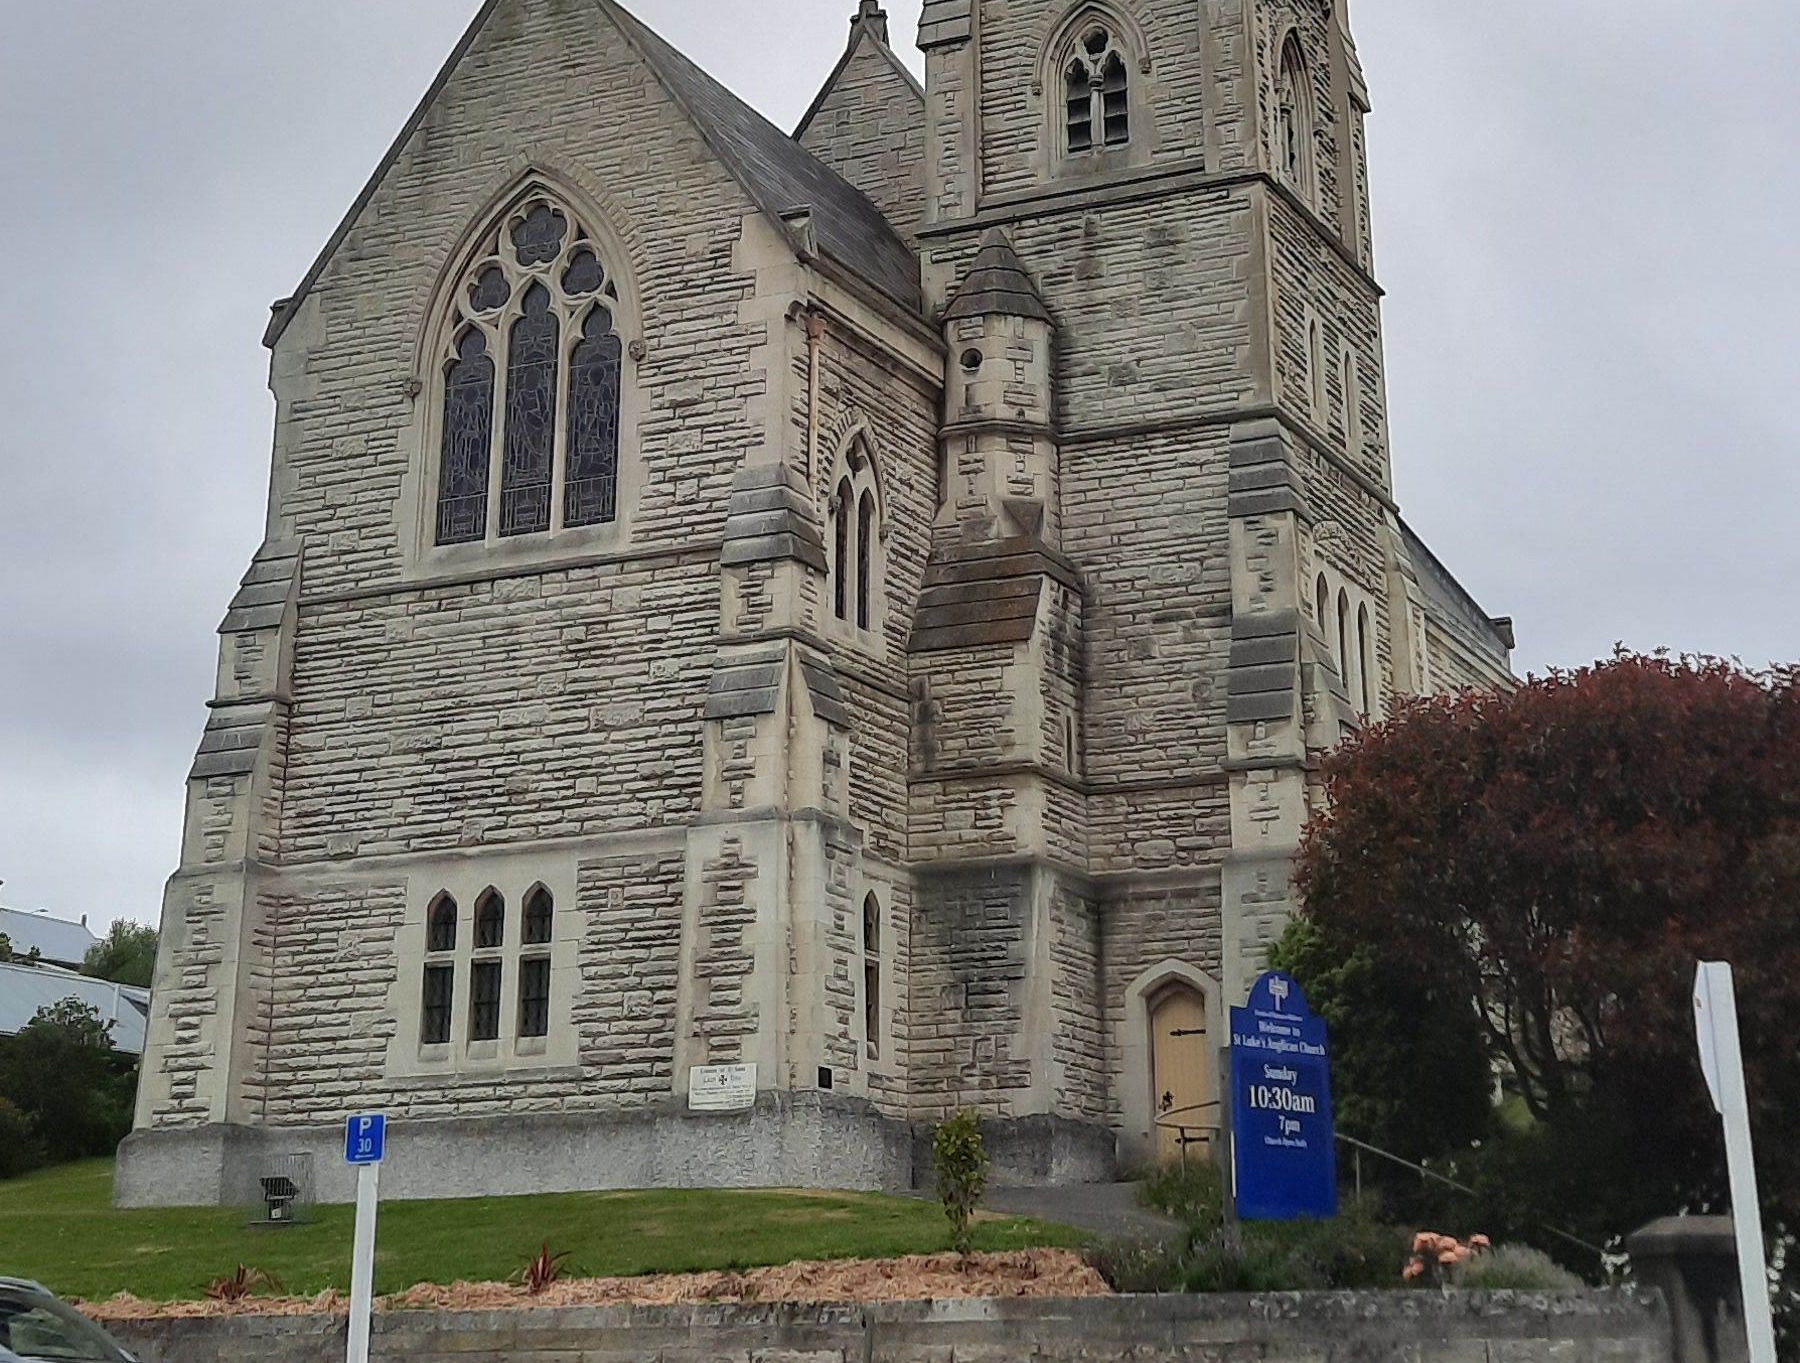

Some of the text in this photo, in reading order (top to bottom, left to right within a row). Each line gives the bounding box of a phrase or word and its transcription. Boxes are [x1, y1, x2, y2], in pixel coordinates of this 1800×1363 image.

[1258, 1020, 1301, 1037] Welcome to
[1233, 1034, 1326, 1056] St Luke's Anglican Church
[1264, 1063, 1297, 1086] Sunday
[1249, 1084, 1315, 1113] 10:30am
[359, 1117, 372, 1136] P
[357, 1138, 372, 1153] 30
